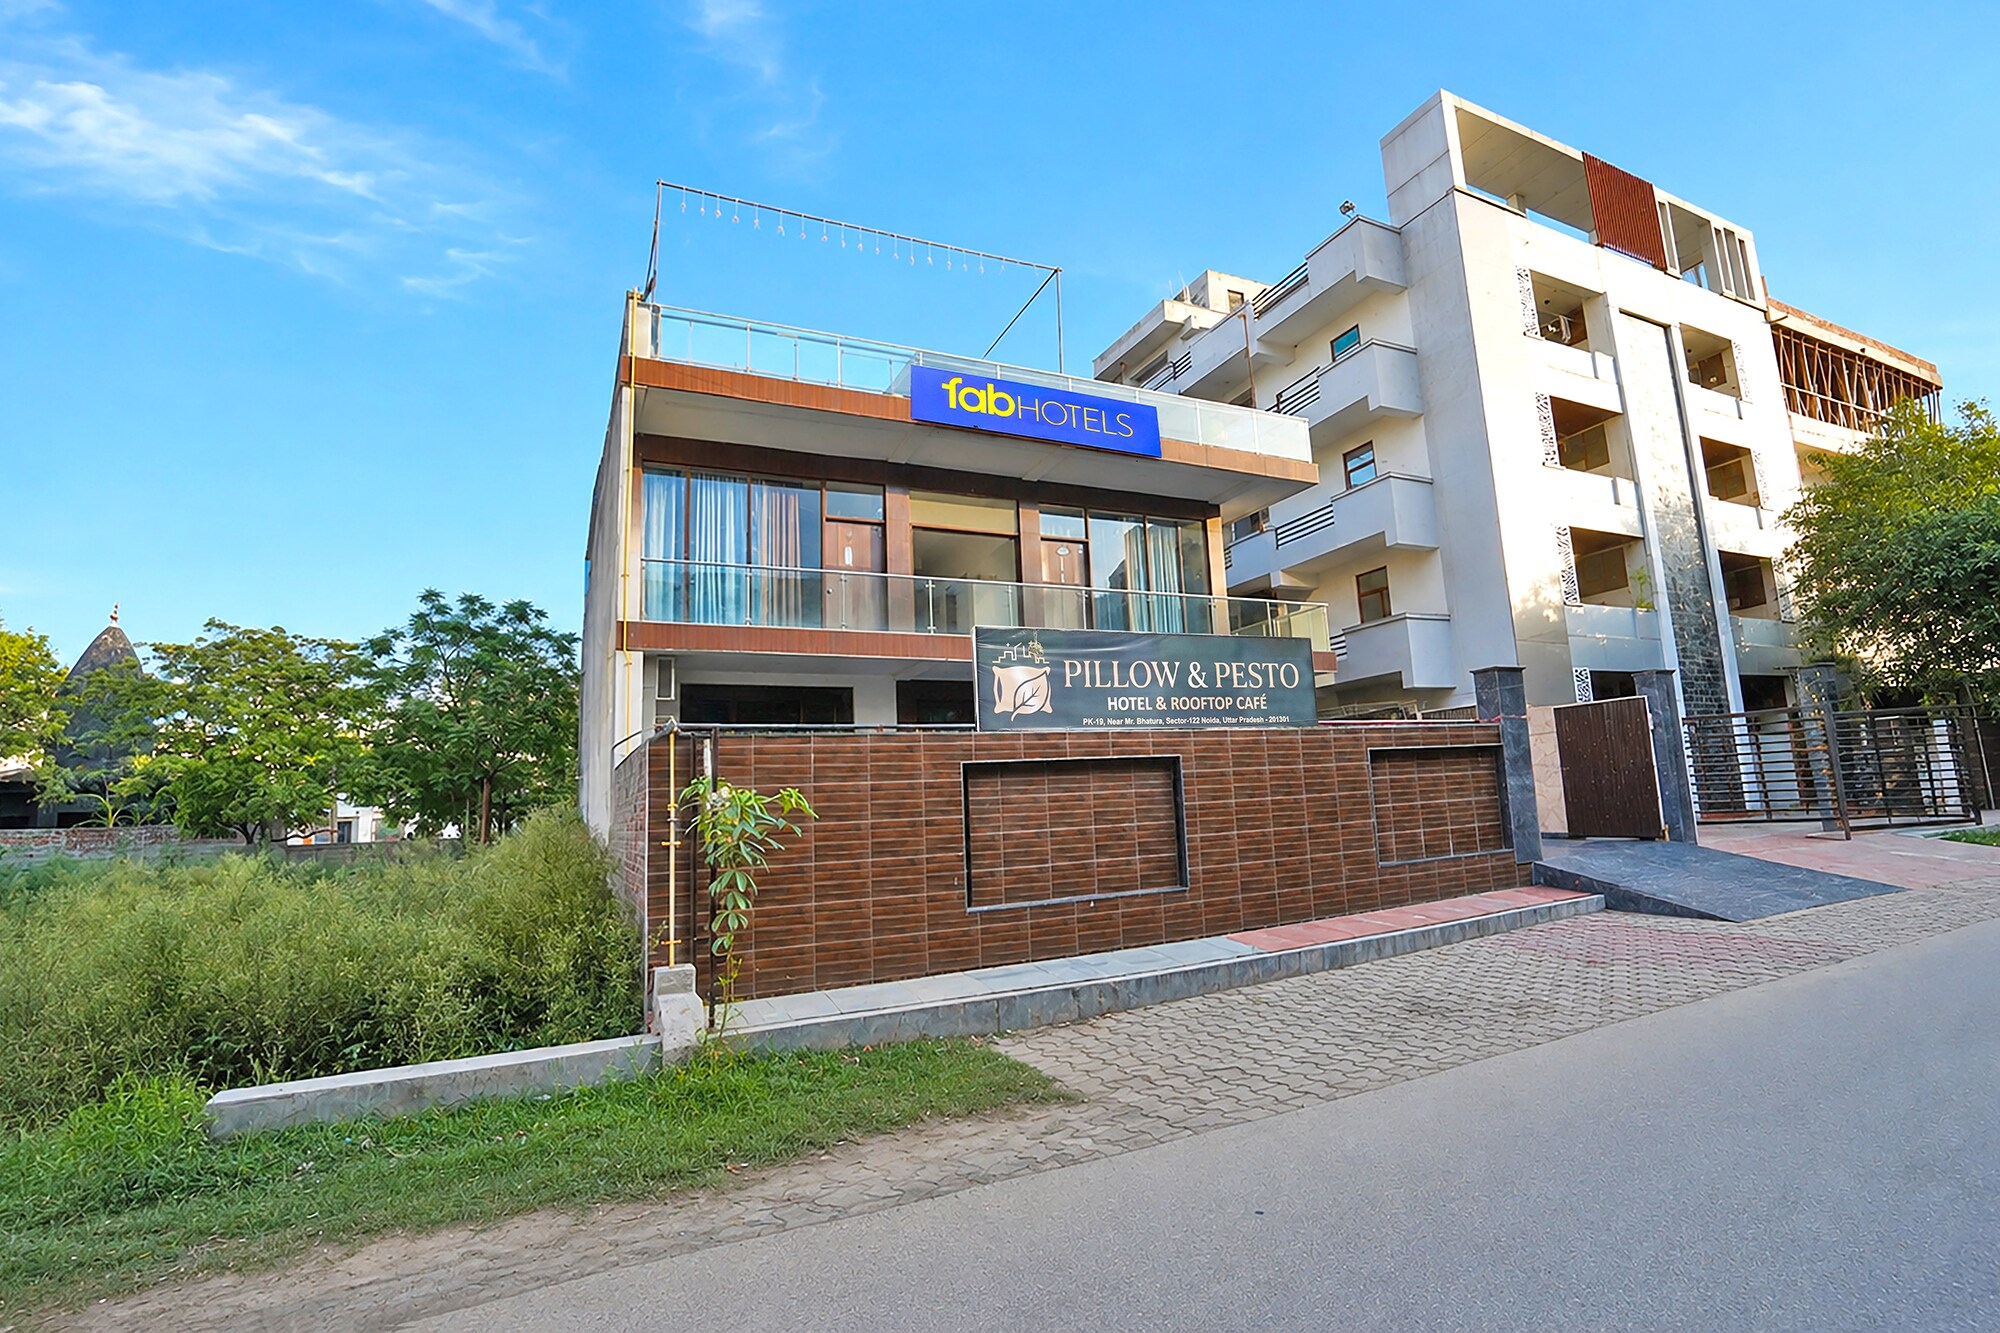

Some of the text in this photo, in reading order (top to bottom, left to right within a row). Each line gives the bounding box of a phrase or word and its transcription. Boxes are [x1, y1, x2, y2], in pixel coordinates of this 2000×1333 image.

[1063, 660, 1300, 690] PILLOW & PESTO
[1107, 693, 1268, 711] HOTEL & ROOFTOP CAFÉ
[1083, 718, 1106, 726] PK-19,
[1107, 718, 1123, 726] Near
[1125, 717, 1136, 725] Mr.
[1137, 717, 1165, 726] Bhatura,
[1166, 717, 1200, 725] Sector-122
[1201, 716, 1222, 725] Noida,
[1223, 716, 1239, 724] Uttar
[1239, 716, 1264, 724] Pradesh
